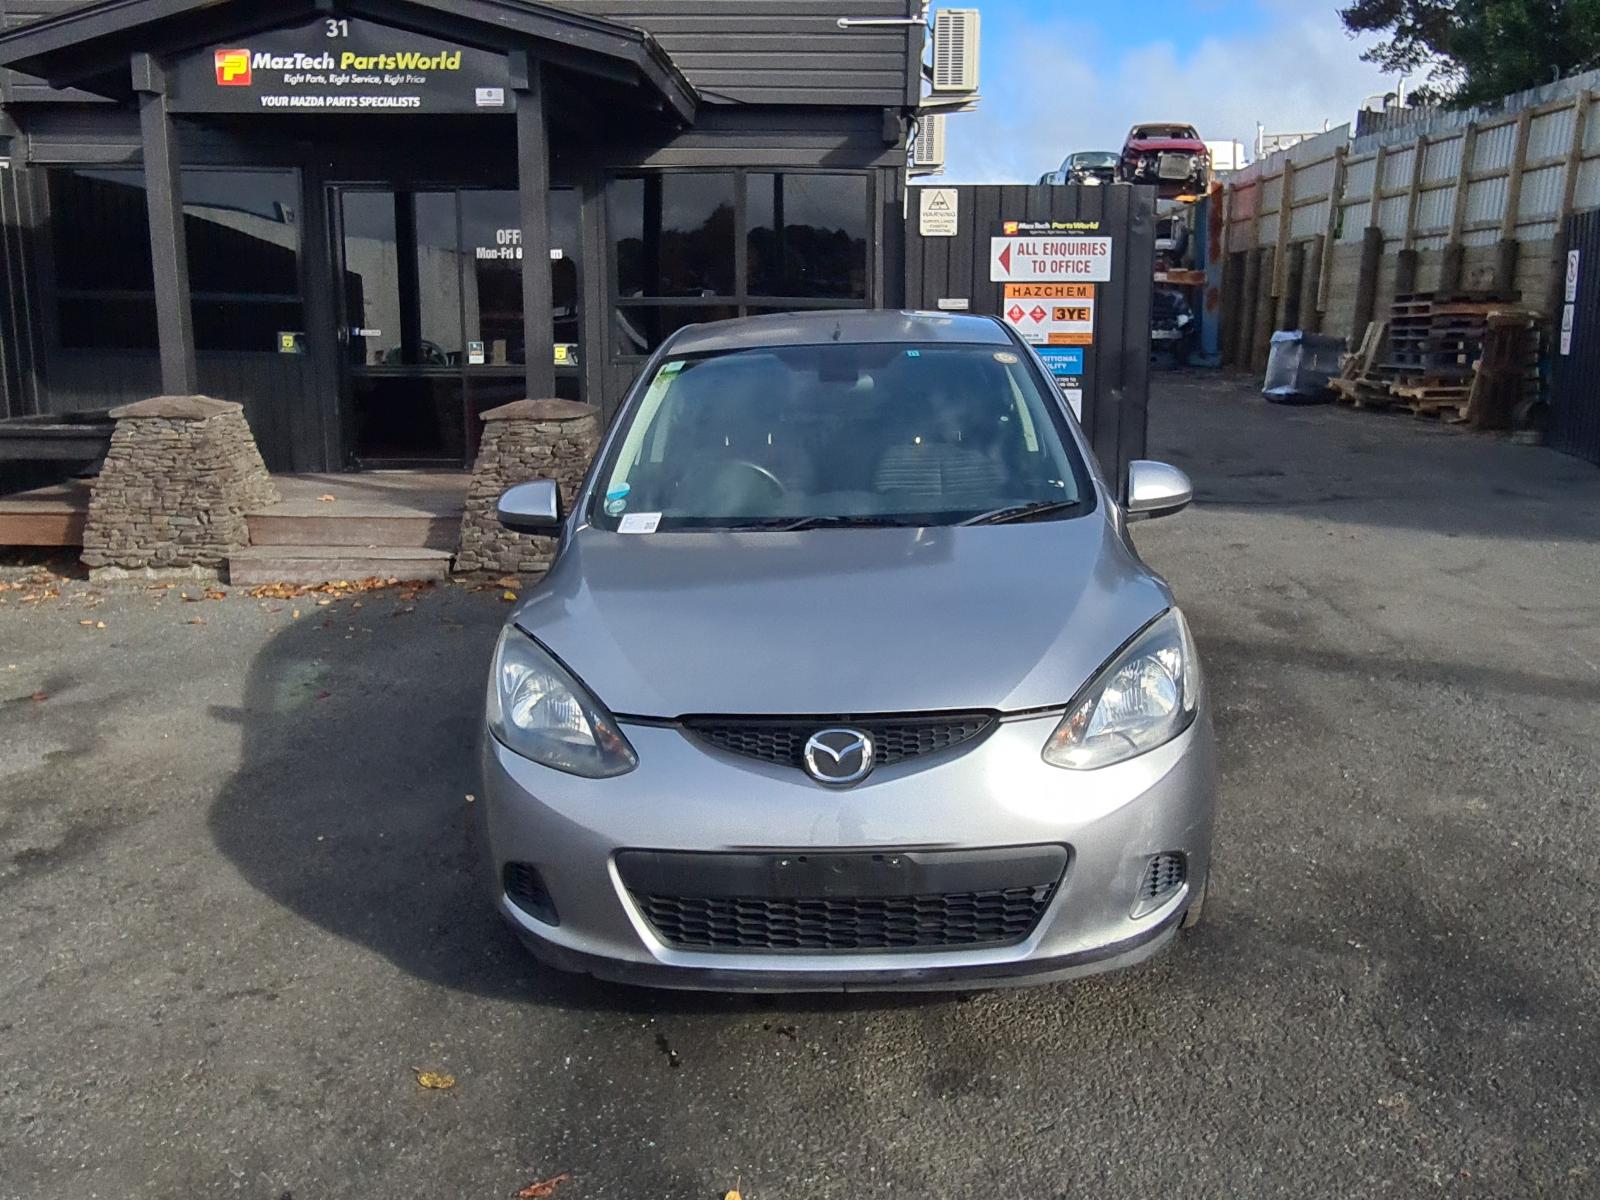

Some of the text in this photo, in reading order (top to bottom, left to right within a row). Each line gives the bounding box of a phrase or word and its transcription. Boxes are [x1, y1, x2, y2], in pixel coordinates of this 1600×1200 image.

[326, 19, 348, 37] 31
[252, 51, 461, 70] MazTech PartsWorld
[284, 74, 426, 86] Right Parts, Right Service, Right Price
[261, 96, 420, 107] YOUR MAZDA PARTS SPECIALISTS
[496, 229, 521, 245] OFF
[476, 247, 514, 259] Mon-Fri
[1017, 242, 1107, 257] ALL ENQUIRIES
[1032, 260, 1091, 274] TO OFFICE
[1012, 286, 1087, 297] HAZCHEM
[1056, 308, 1086, 320] 3YE
